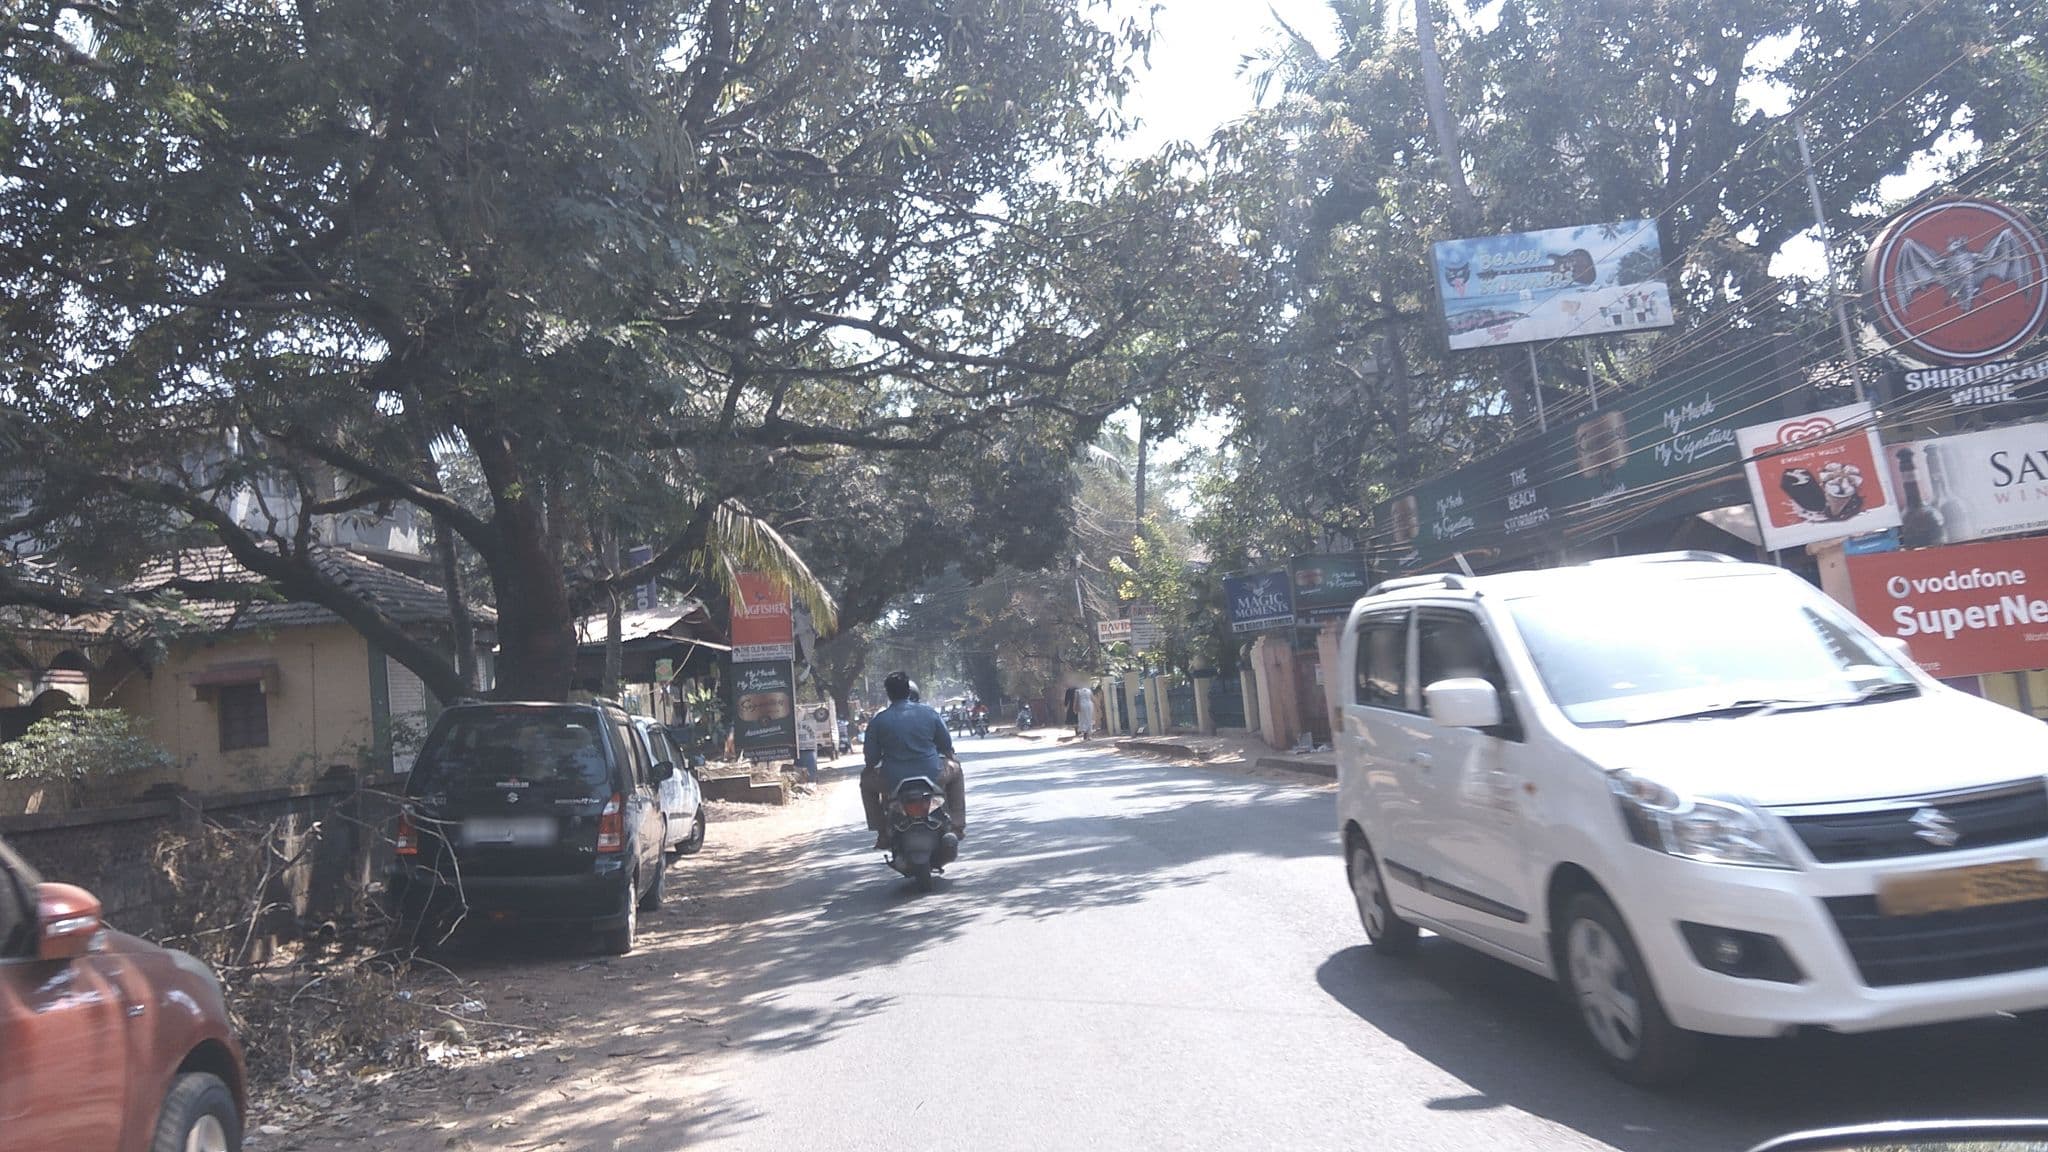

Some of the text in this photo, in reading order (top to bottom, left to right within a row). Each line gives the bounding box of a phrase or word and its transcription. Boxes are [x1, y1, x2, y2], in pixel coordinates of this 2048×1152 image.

[1673, 428, 1735, 464] Signature
[1510, 467, 1528, 487] THE
[1508, 488, 1537, 511] BEACH
[1912, 567, 2027, 594] vodafone
[734, 602, 789, 618] KNGFISHER
[1235, 602, 1289, 618] MOMENTS
[1237, 592, 1283, 611] MAGIC
[1892, 594, 2048, 640] SuperNe
